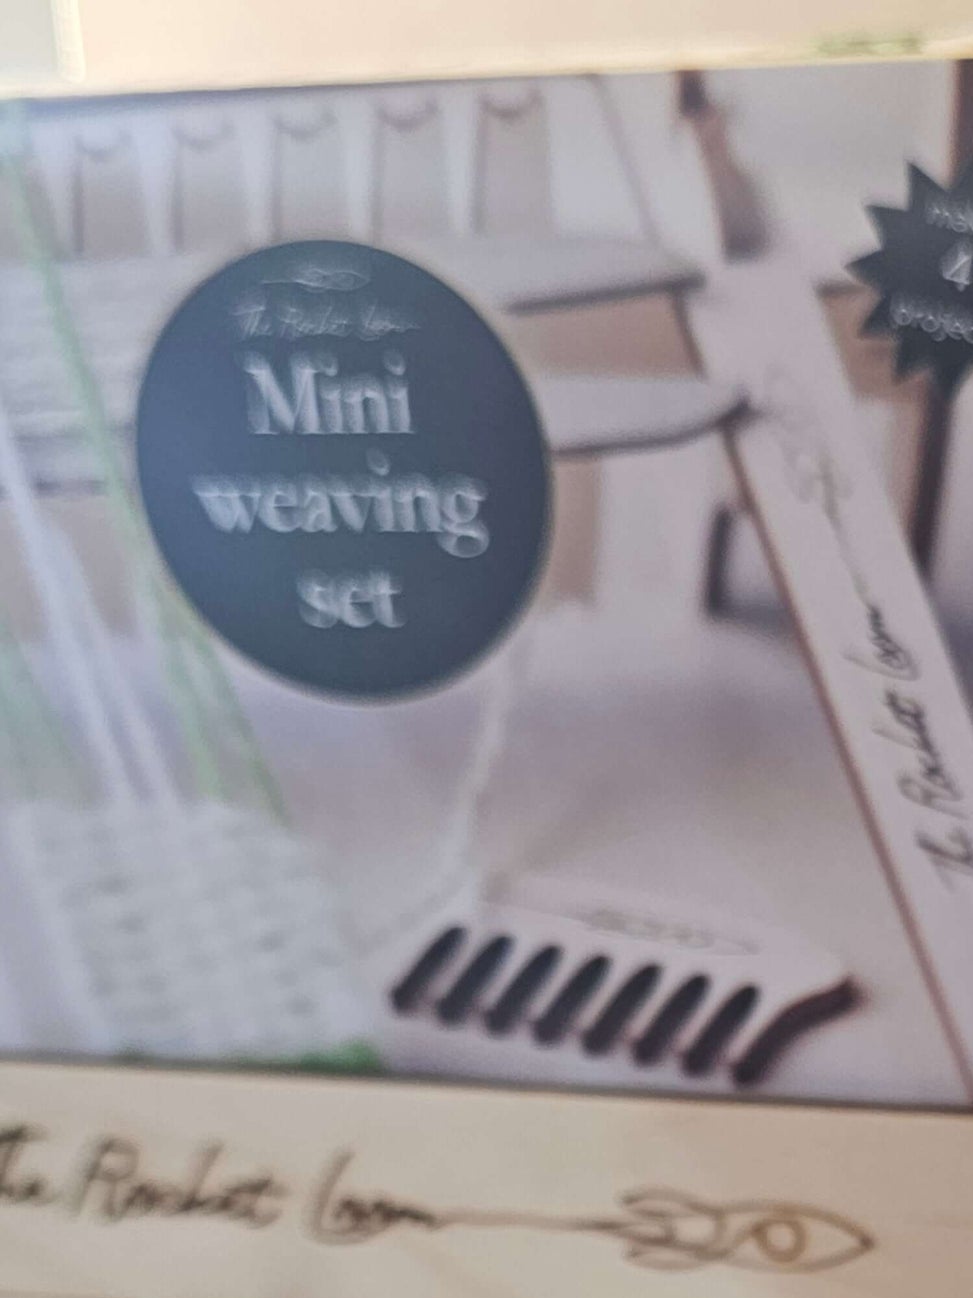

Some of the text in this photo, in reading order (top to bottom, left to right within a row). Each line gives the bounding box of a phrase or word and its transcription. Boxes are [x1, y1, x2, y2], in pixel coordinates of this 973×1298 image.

[240, 350, 413, 434] Mini
[194, 446, 489, 558] weaving
[298, 568, 404, 628] set
[303, 1143, 440, 1246] Loom
